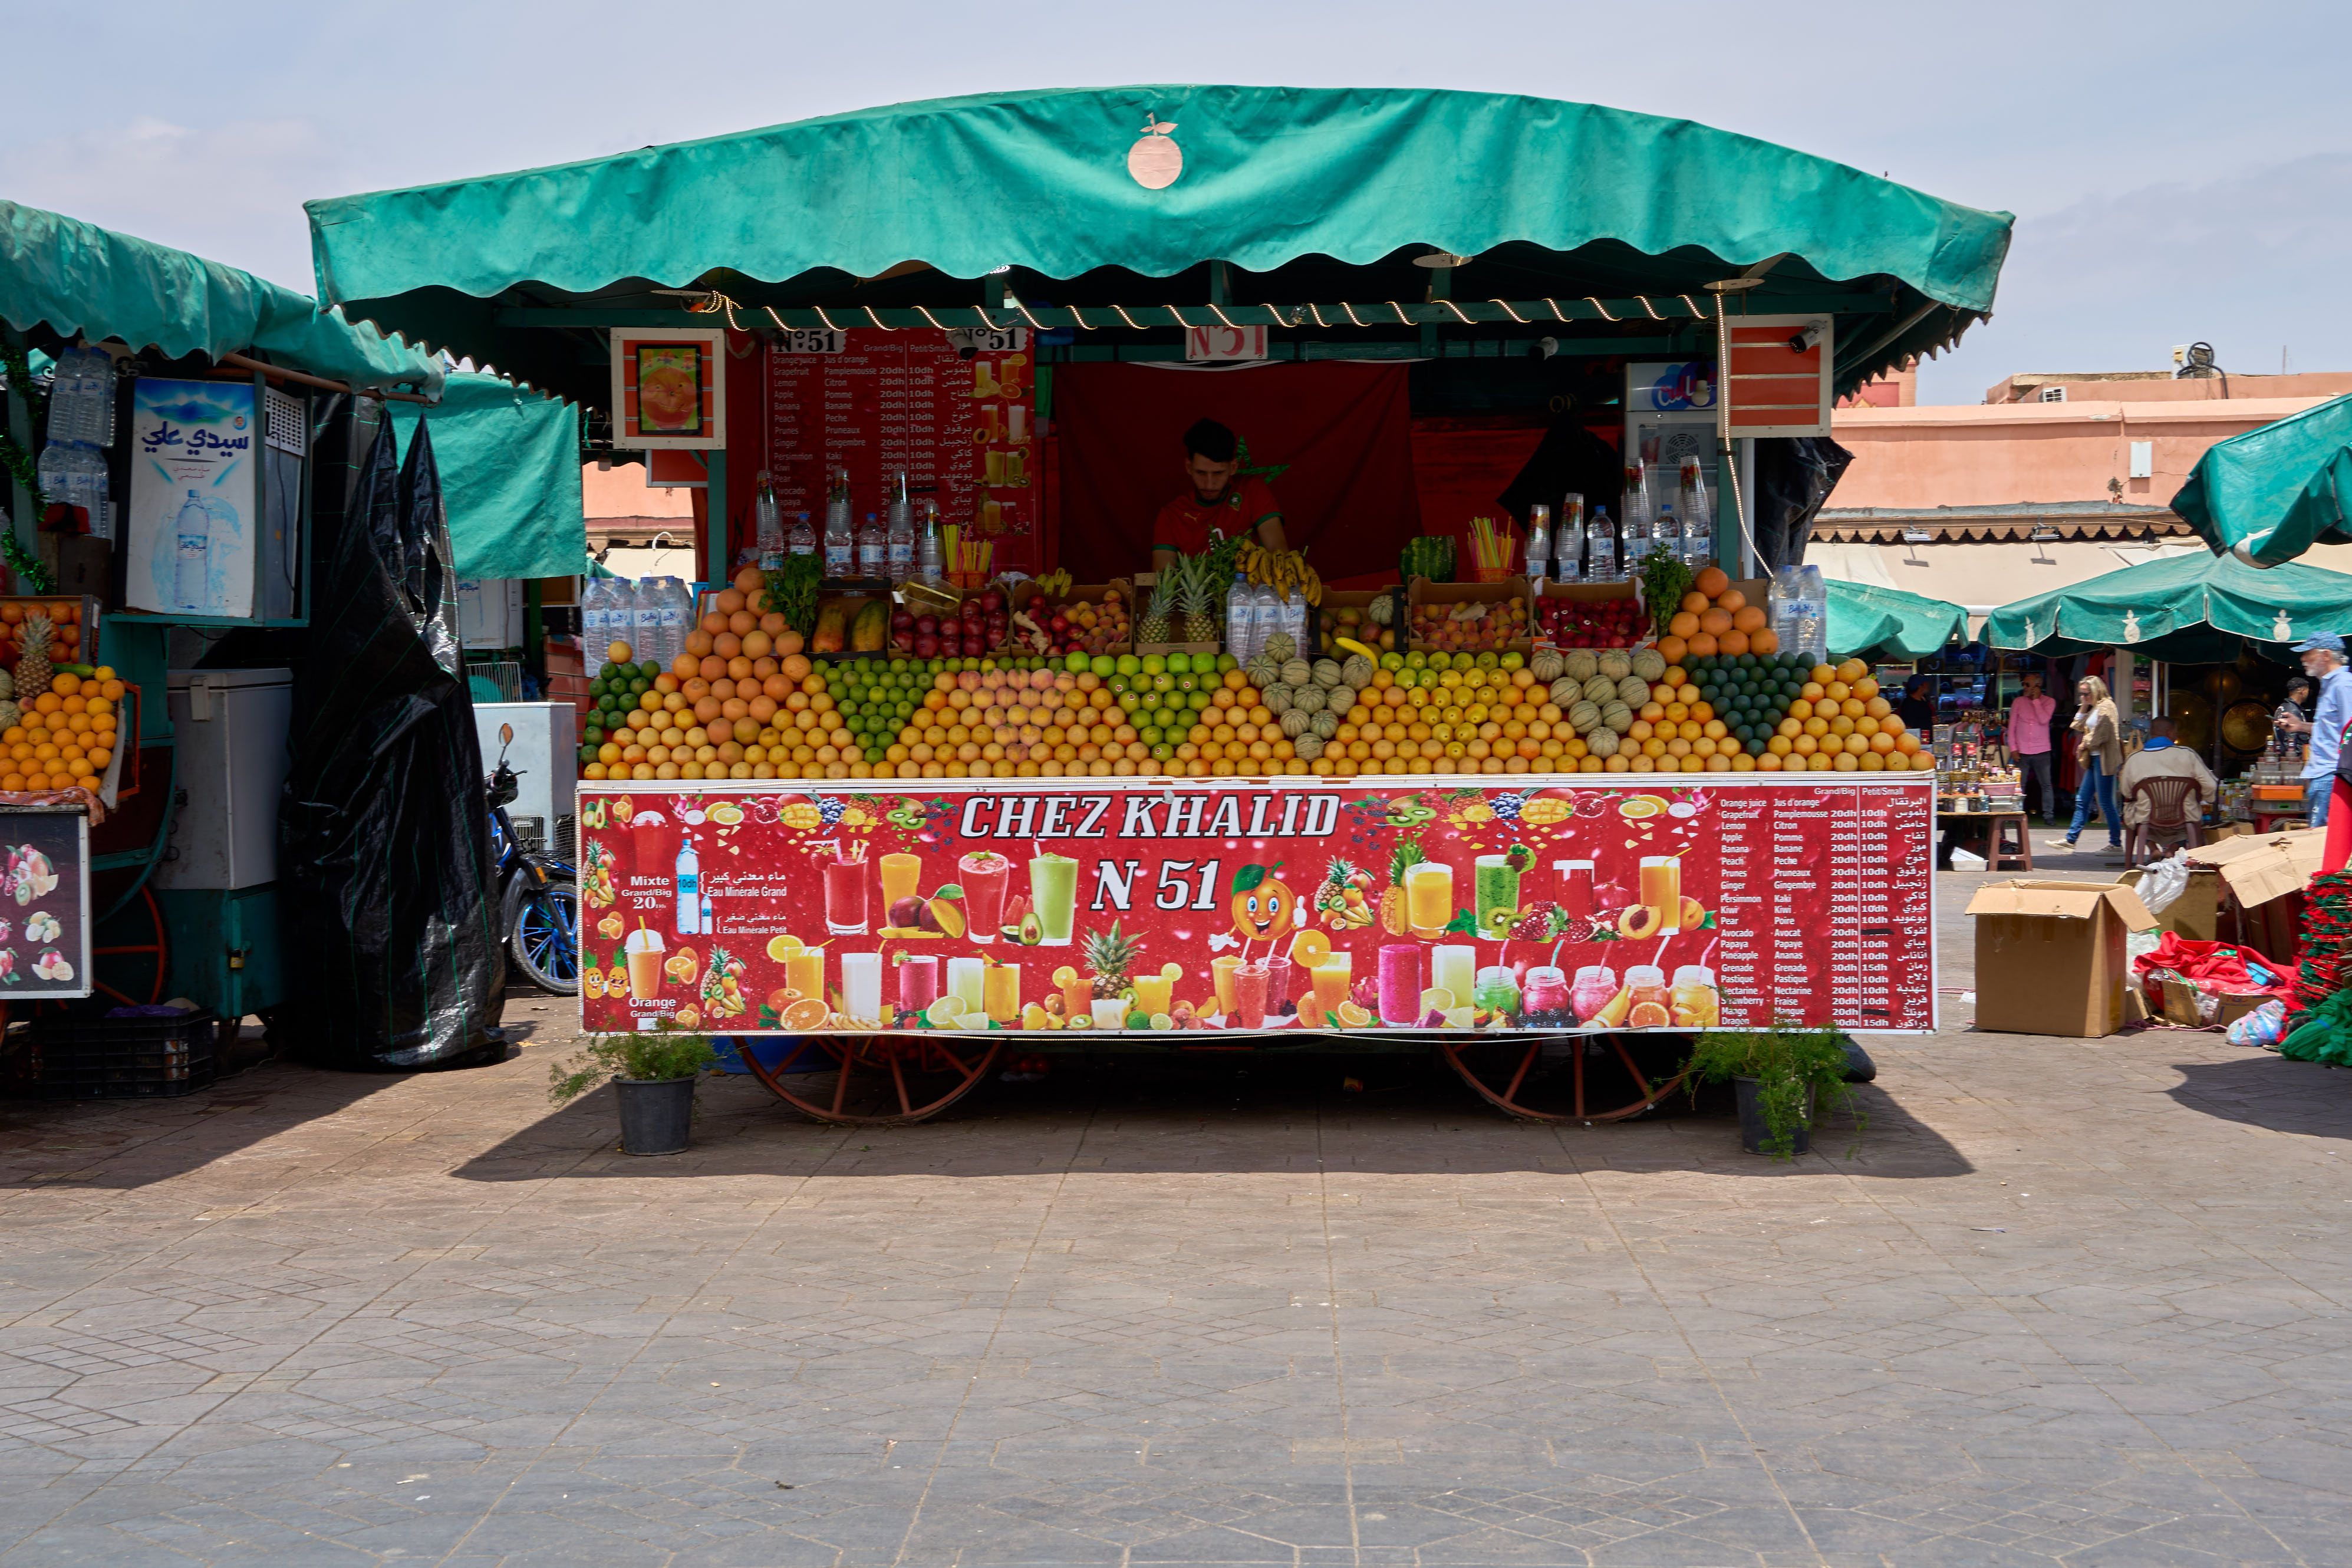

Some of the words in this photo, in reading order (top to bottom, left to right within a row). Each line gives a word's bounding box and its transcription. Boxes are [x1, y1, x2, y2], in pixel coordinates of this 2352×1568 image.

[773, 368, 809, 376] Grapefruit
[774, 391, 794, 400] Apple
[825, 414, 848, 422] Peche
[141, 421, 183, 453] علي
[186, 429, 250, 457] سيدي
[774, 439, 797, 447] Ginger
[825, 439, 866, 448] Gingembre
[1720, 799, 1747, 808] Orange
[1748, 799, 1767, 808] juice
[1787, 799, 1820, 808] d'orange
[1887, 798, 1926, 807] البرتقال
[960, 795, 1112, 838] CHEZ
[1118, 793, 1342, 838] KHALID
[1721, 811, 1759, 820] Grapefruit
[1774, 811, 1828, 819] Pamplemousse
[1895, 821, 1928, 829] حامض
[1721, 834, 1743, 842] Apple
[1904, 832, 1926, 842] تفاح
[1910, 843, 1926, 852] موز
[1905, 854, 1926, 865] خوخ
[768, 872, 786, 881] ماء
[1896, 867, 1926, 877] برقوق
[631, 876, 670, 886] Mixte
[710, 872, 730, 884] كبير
[733, 872, 765, 884] معدني
[1090, 859, 1141, 911] N
[1155, 858, 1220, 911] 51
[1721, 881, 1746, 891] Ginger
[1774, 881, 1817, 891] Gingembre
[1892, 879, 1927, 890] زنجبيل
[621, 889, 672, 897] Grand/Big
[707, 887, 723, 897] Eau
[724, 885, 759, 897] Minérale
[761, 886, 787, 897] Grand
[1904, 892, 1927, 902] كاكي
[633, 897, 656, 909] 20
[1721, 905, 1738, 914] Kiwi
[1903, 904, 1926, 913] كيوي
[725, 911, 745, 922] صغير
[747, 914, 770, 923] معدني
[1721, 940, 1748, 949] Papaya
[1774, 940, 1803, 949] Papaye
[1721, 951, 1759, 961] Pineapple
[1907, 962, 1928, 970] رمان
[1721, 975, 1754, 984] Pastique
[1774, 975, 1808, 984] Pastique
[629, 997, 676, 1009] Orange
